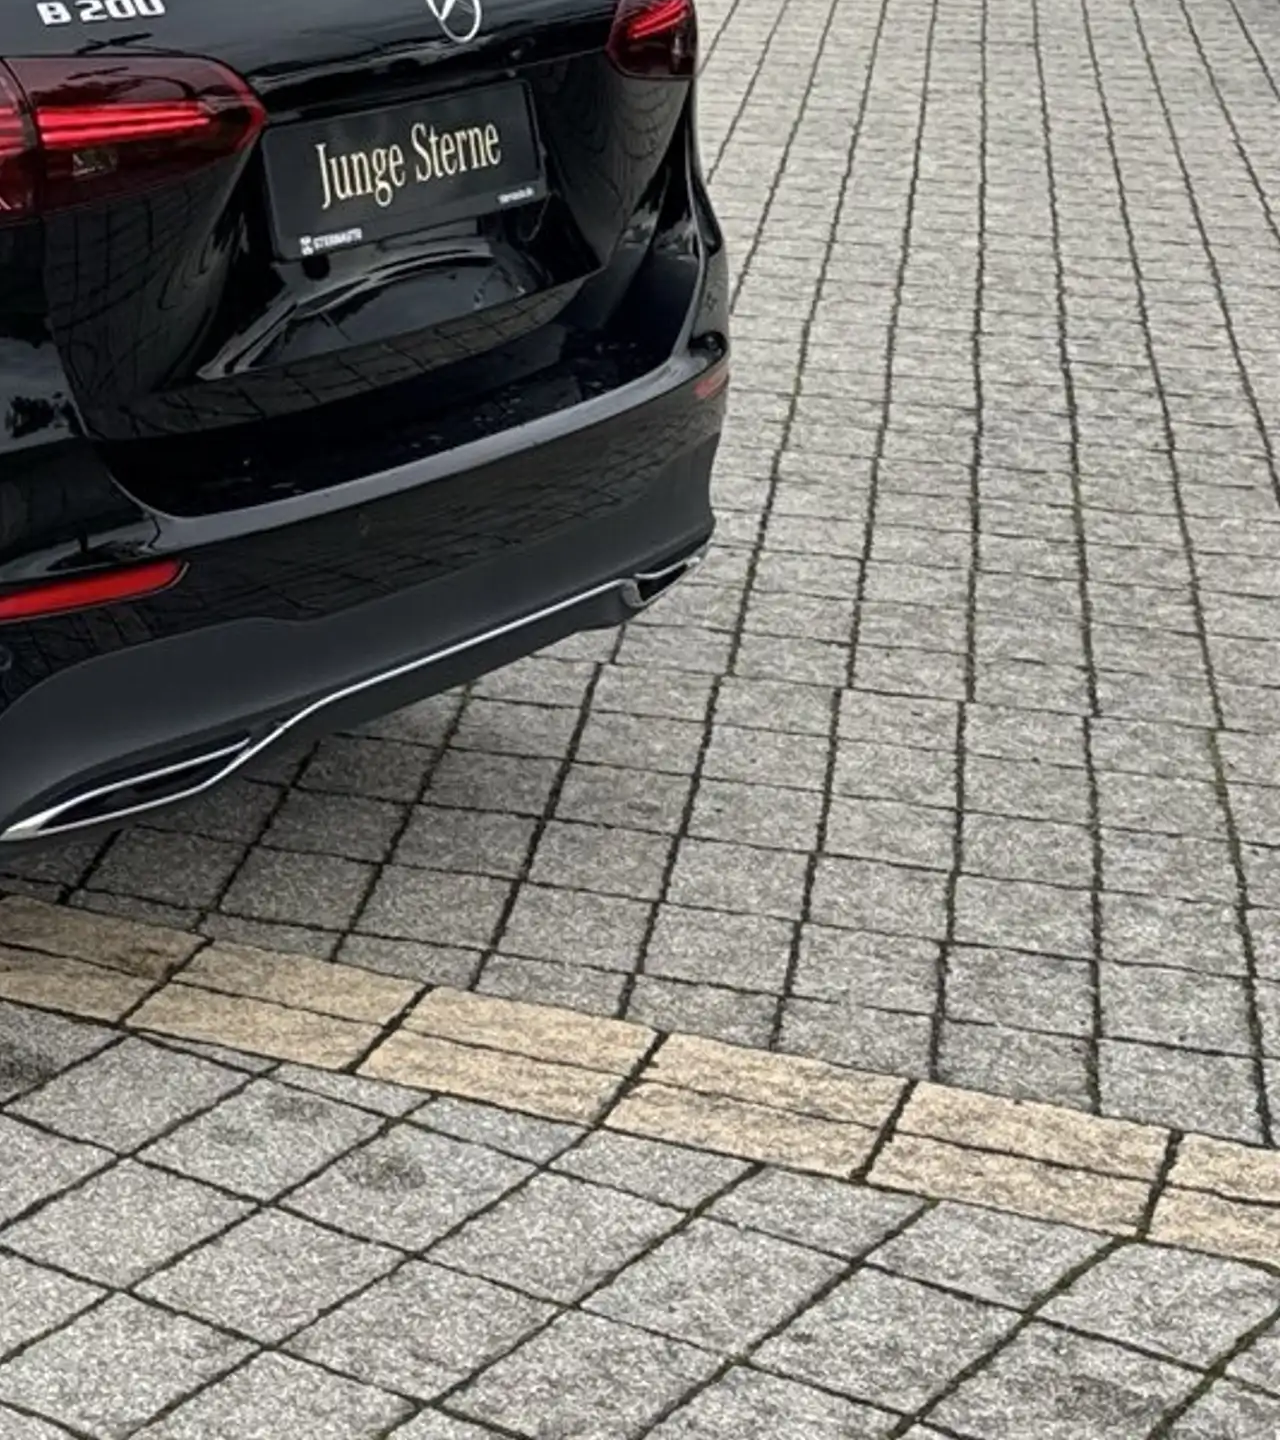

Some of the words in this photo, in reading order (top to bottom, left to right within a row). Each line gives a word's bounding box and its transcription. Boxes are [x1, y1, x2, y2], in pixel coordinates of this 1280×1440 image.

[36, 1, 72, 25] B
[315, 142, 406, 209] Junge
[410, 122, 502, 183] Sterne
